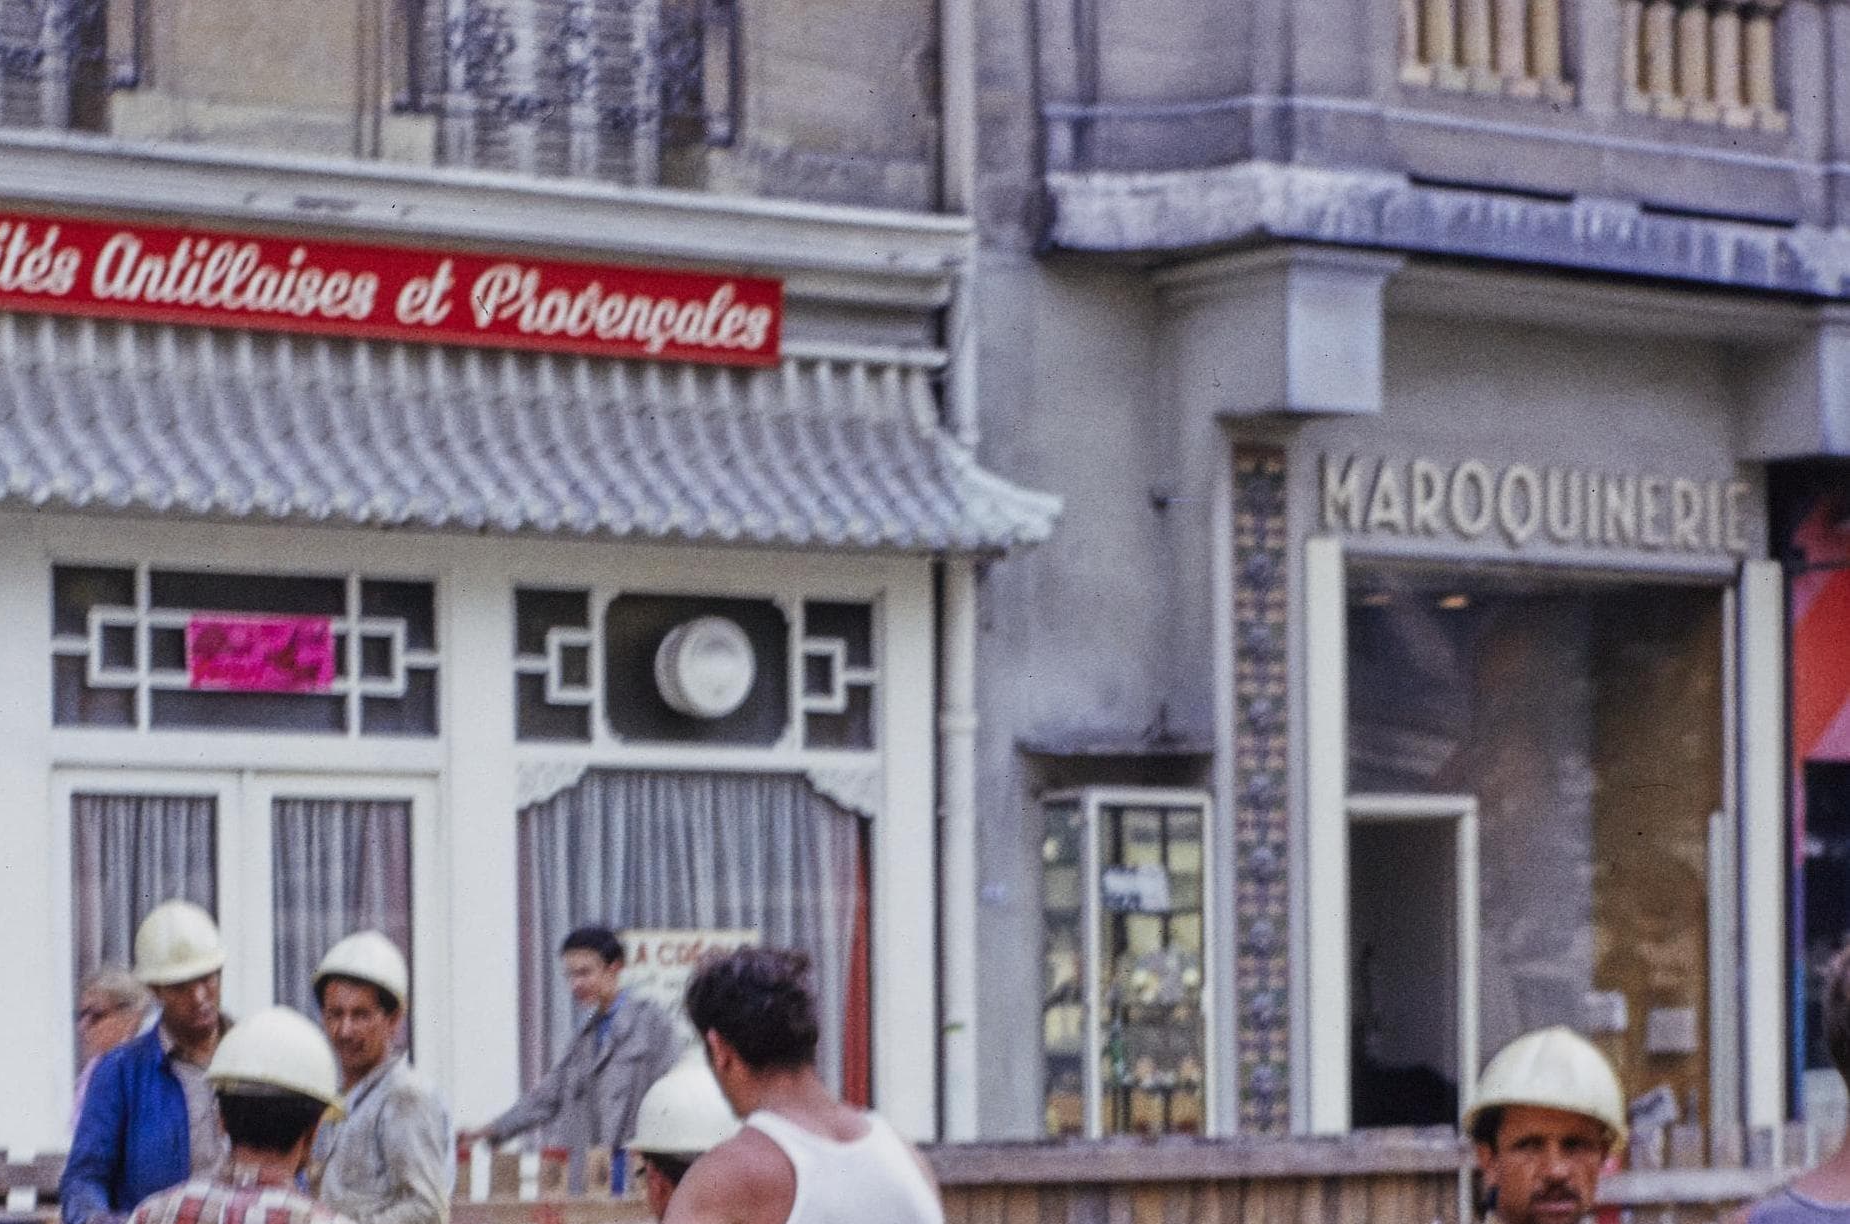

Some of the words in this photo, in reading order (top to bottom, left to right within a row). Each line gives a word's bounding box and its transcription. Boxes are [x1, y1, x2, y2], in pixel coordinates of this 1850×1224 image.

[90, 233, 379, 320] Antillaises
[396, 260, 453, 326] et
[470, 263, 773, 354] Provençales
[1321, 453, 1751, 551] MAROQUINERIE
